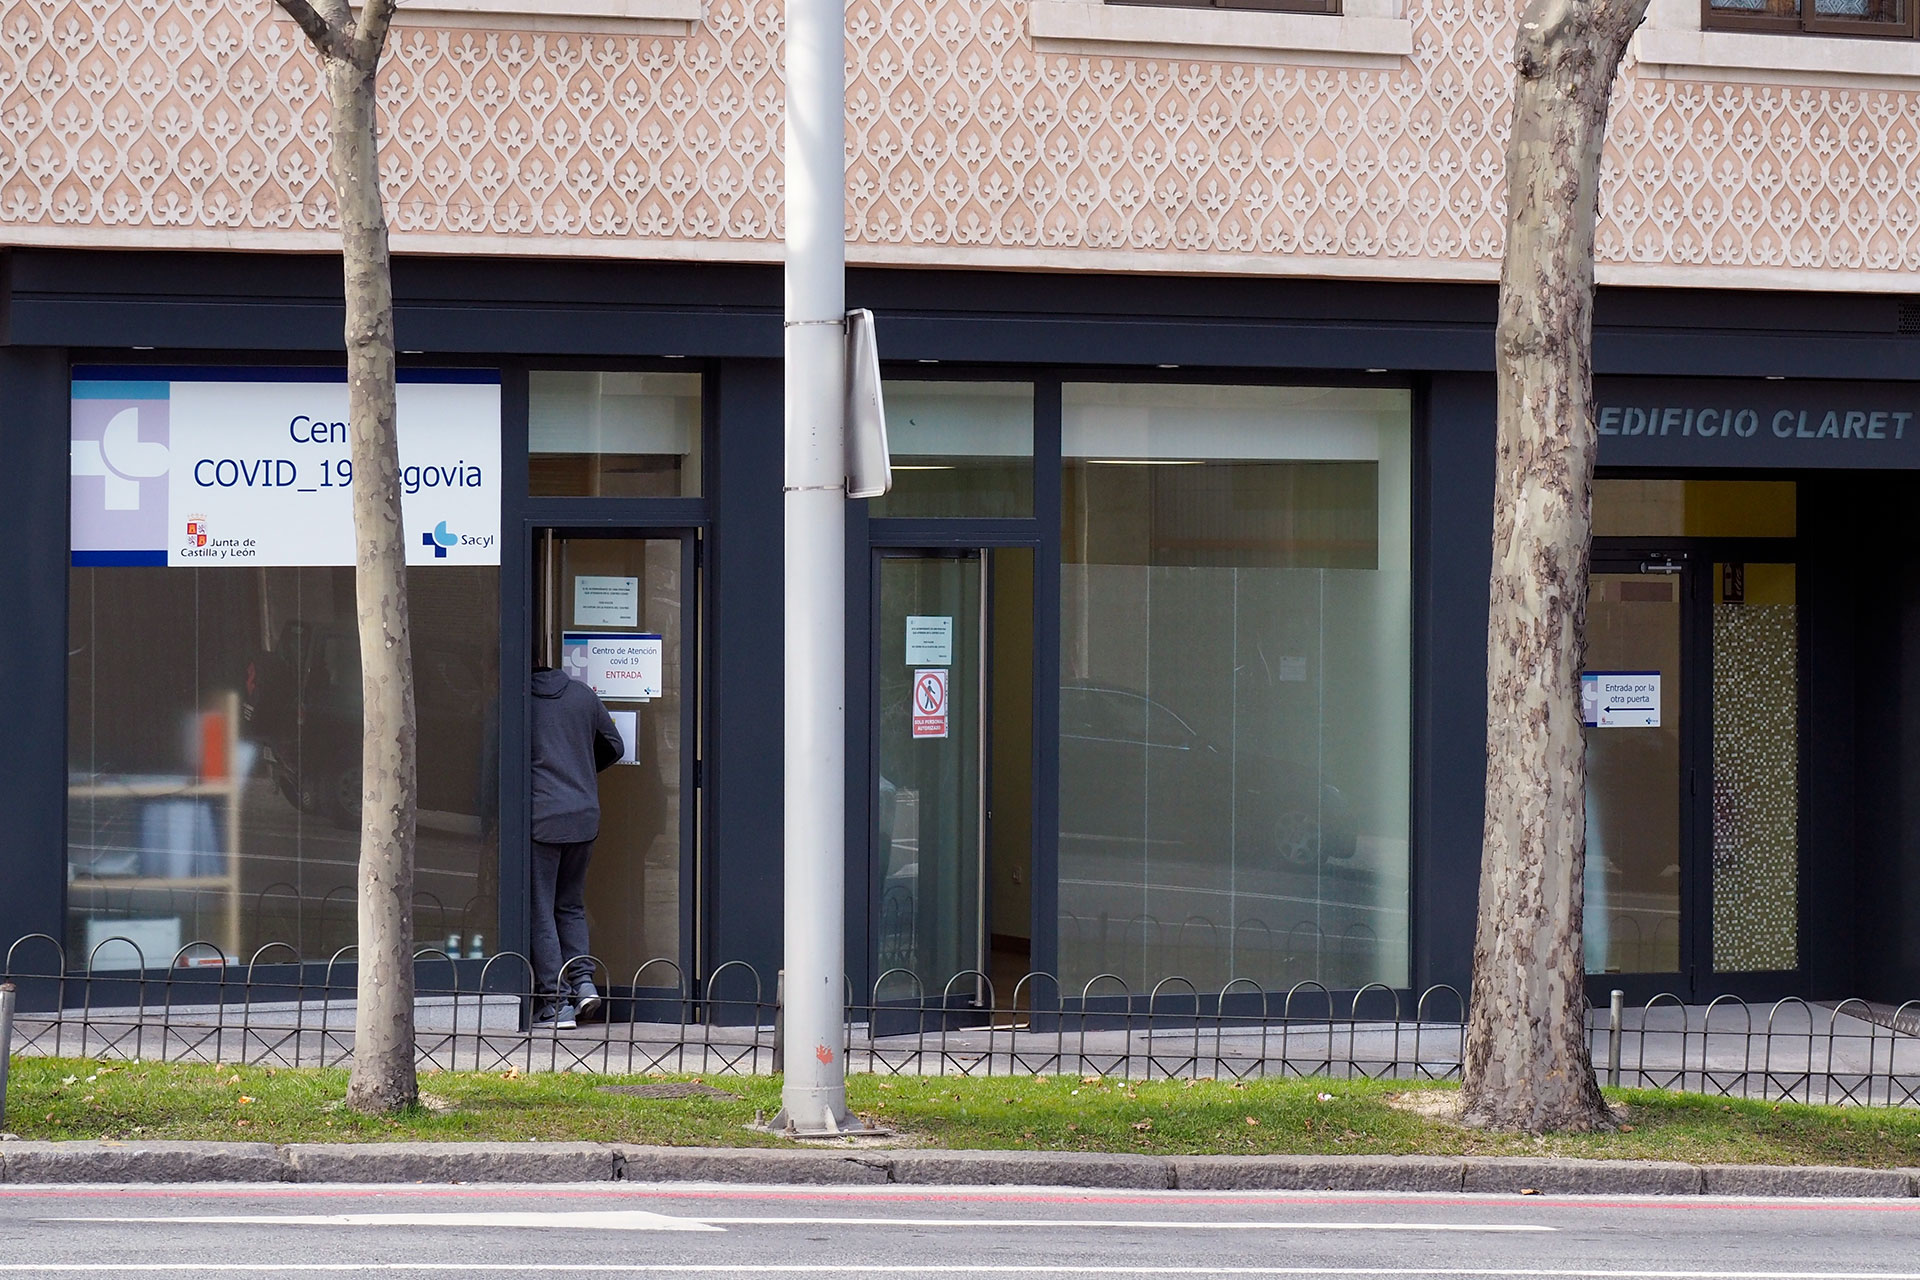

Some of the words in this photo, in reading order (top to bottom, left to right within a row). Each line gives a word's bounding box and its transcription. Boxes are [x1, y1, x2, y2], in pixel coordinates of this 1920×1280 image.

[1598, 407, 1759, 438] EDIFICIO
[1771, 409, 1914, 440] CLARET
[289, 415, 350, 443] Cen
[194, 459, 353, 492] COVID_19
[398, 460, 482, 494] govia
[210, 538, 240, 547] Junta
[242, 538, 256, 547] de
[461, 534, 494, 549] Sacyl
[180, 548, 218, 557] Castilla
[220, 550, 228, 560] y
[230, 548, 256, 557] León
[592, 646, 615, 655] Centro
[616, 647, 626, 655] de
[627, 646, 657, 655] Atención
[610, 657, 629, 665] covid
[630, 657, 640, 665] 19
[605, 670, 642, 679] ENTRADA
[1605, 683, 1633, 692] Entrada
[1634, 685, 1647, 693] por
[1648, 683, 1655, 692] la
[1610, 695, 1625, 703] otra
[1626, 695, 1650, 705] puerta
